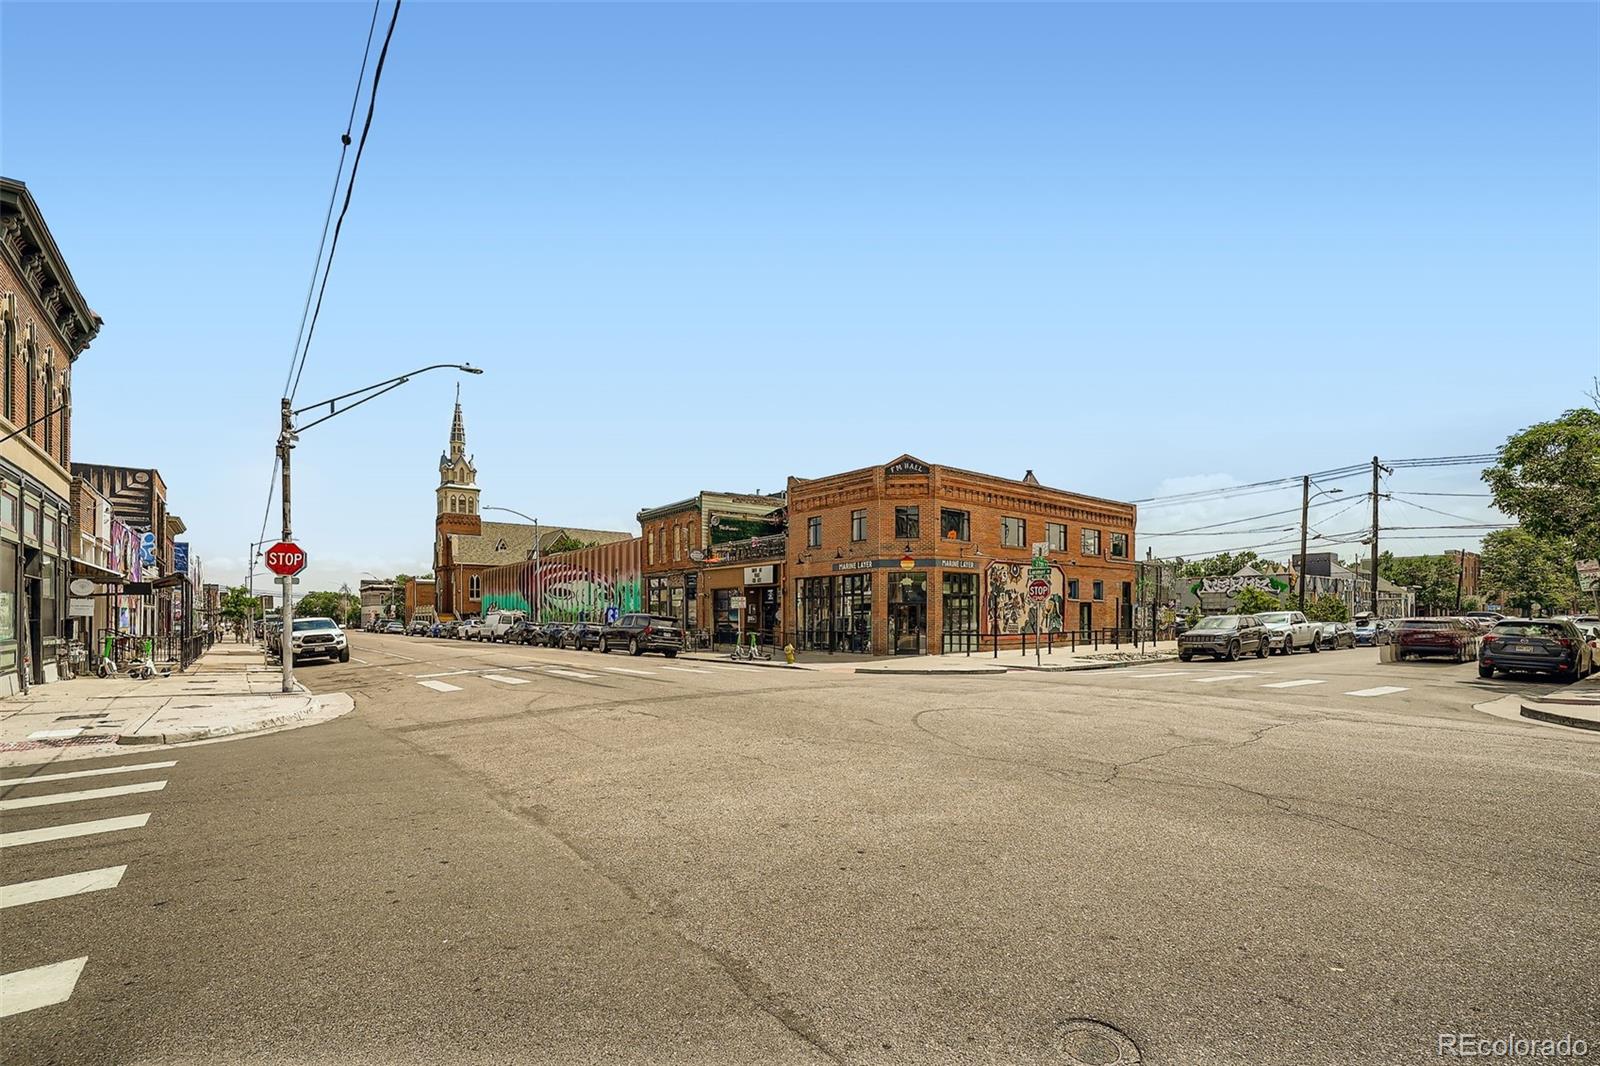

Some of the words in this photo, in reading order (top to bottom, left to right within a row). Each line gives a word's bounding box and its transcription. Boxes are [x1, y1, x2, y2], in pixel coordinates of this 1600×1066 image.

[269, 552, 303, 566] STOP
[838, 561, 857, 570] MARINE
[857, 560, 873, 569] LAYER
[1030, 586, 1048, 596] STOP
